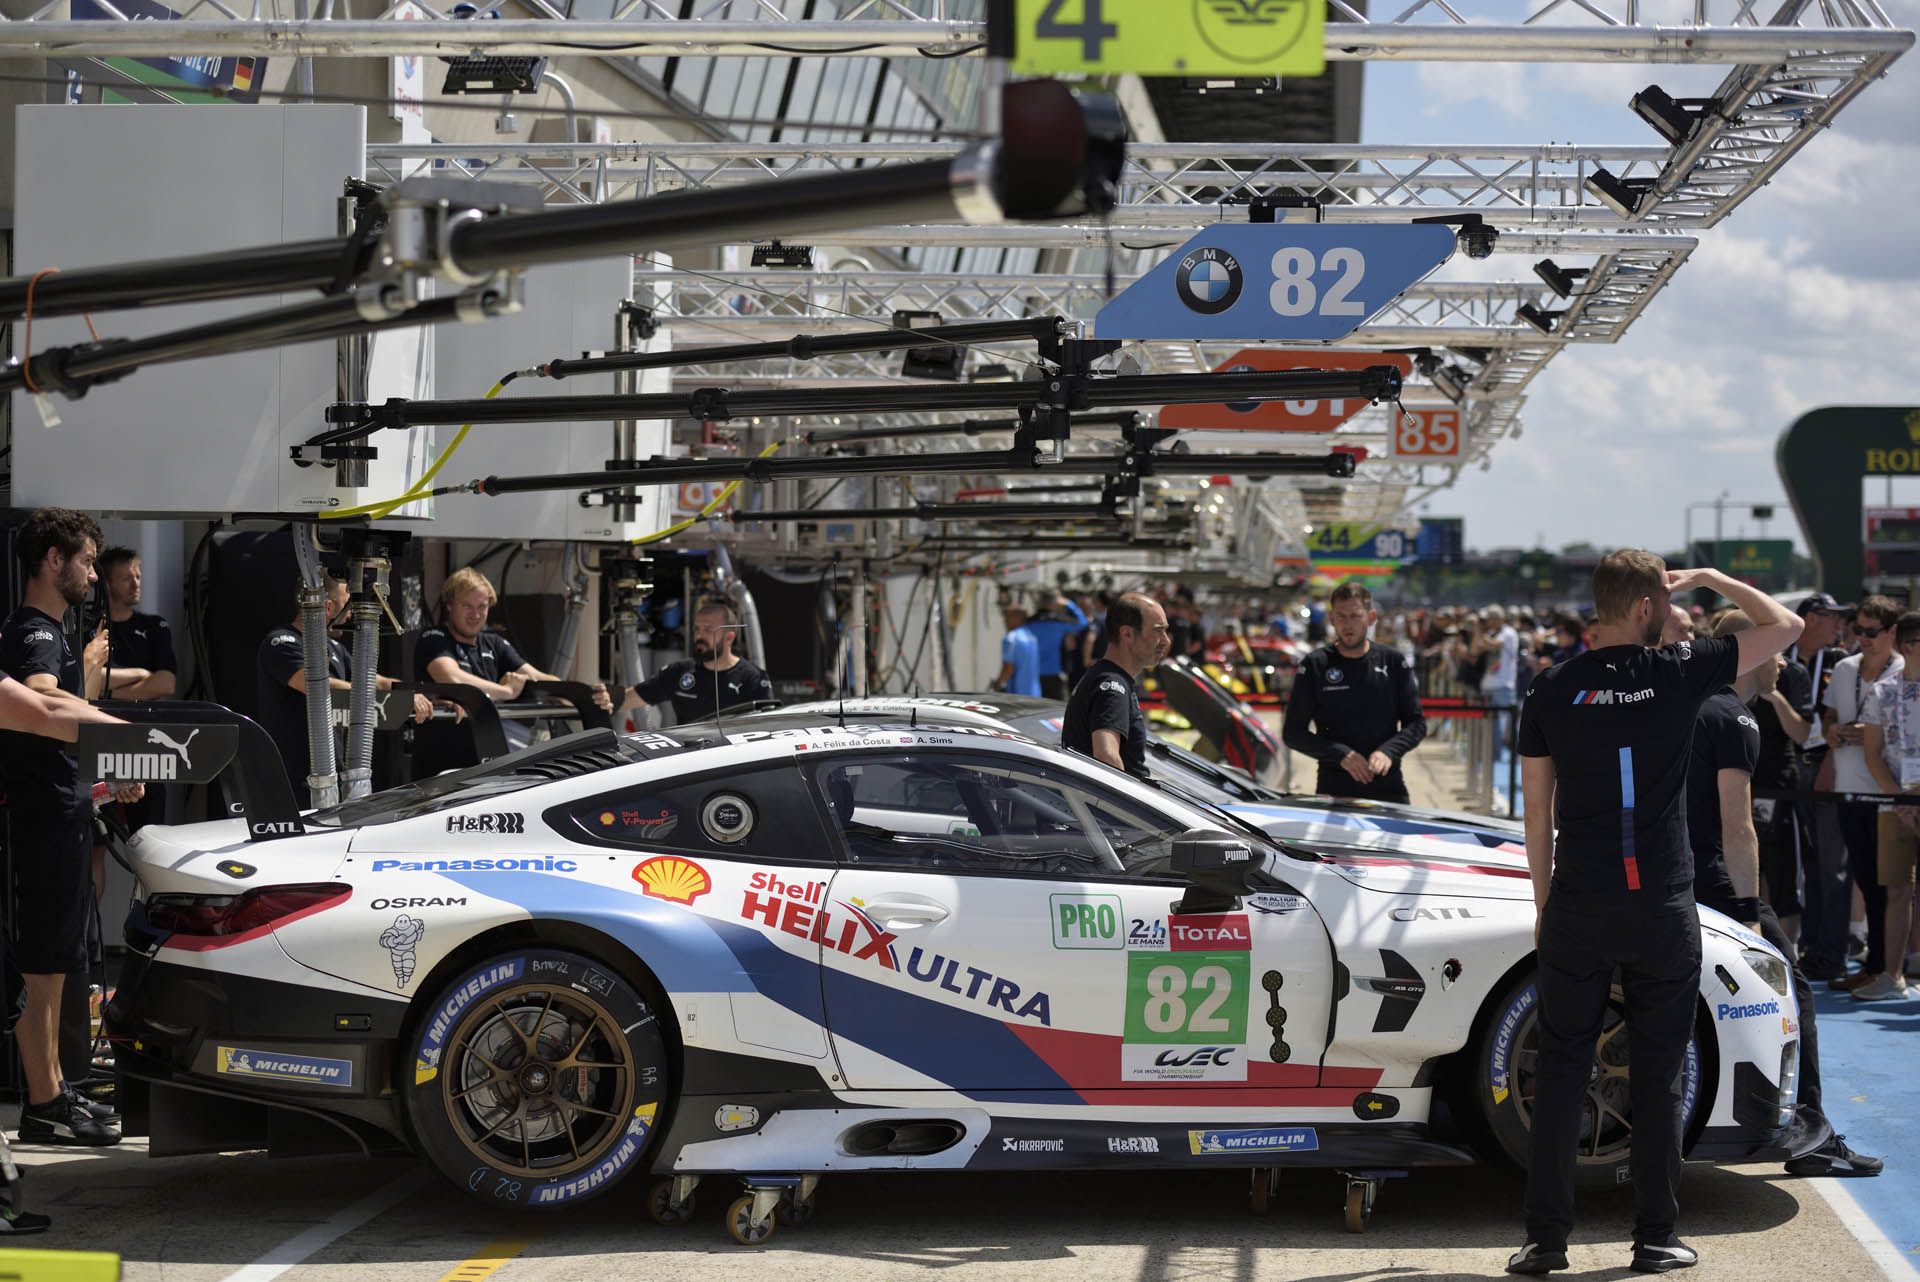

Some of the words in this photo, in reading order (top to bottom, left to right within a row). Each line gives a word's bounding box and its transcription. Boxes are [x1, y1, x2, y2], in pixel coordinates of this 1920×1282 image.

[1182, 249, 1238, 271] BMW
[1269, 246, 1365, 317] 82
[1400, 413, 1456, 453] 85
[1318, 528, 1350, 547] 44
[1375, 534, 1402, 557] 90
[1615, 688, 1655, 704] Team
[849, 738, 861, 746] da
[863, 737, 891, 746] Costa
[917, 736, 927, 744] A.
[929, 736, 953, 745] Sims
[98, 752, 177, 780] PUMA
[252, 821, 301, 835] CATL
[447, 814, 503, 834] H&R
[372, 855, 578, 873] Panasonic
[1224, 850, 1249, 861] PUMA
[749, 871, 823, 904] Shell
[370, 897, 467, 910] OSRAM
[1059, 903, 1116, 939] PRO
[1387, 907, 1487, 922] CATL
[740, 890, 899, 972] HELIX
[1130, 918, 1166, 939] 24h
[1173, 924, 1248, 941] TOTAL
[906, 946, 1051, 1027] ULTRA
[428, 962, 516, 1043] MICHELIN
[1143, 964, 1232, 1033] 82
[687, 1013, 696, 1022] 82
[1717, 1001, 1779, 1020] Panasonic
[1493, 991, 1532, 1071] MICHELIN
[1154, 1046, 1236, 1067] WEC
[255, 1060, 341, 1078] MICHELIN
[1107, 1137, 1145, 1153] H&R
[1226, 1134, 1305, 1147] MICHELIN
[539, 1138, 636, 1202] MICHELIN
